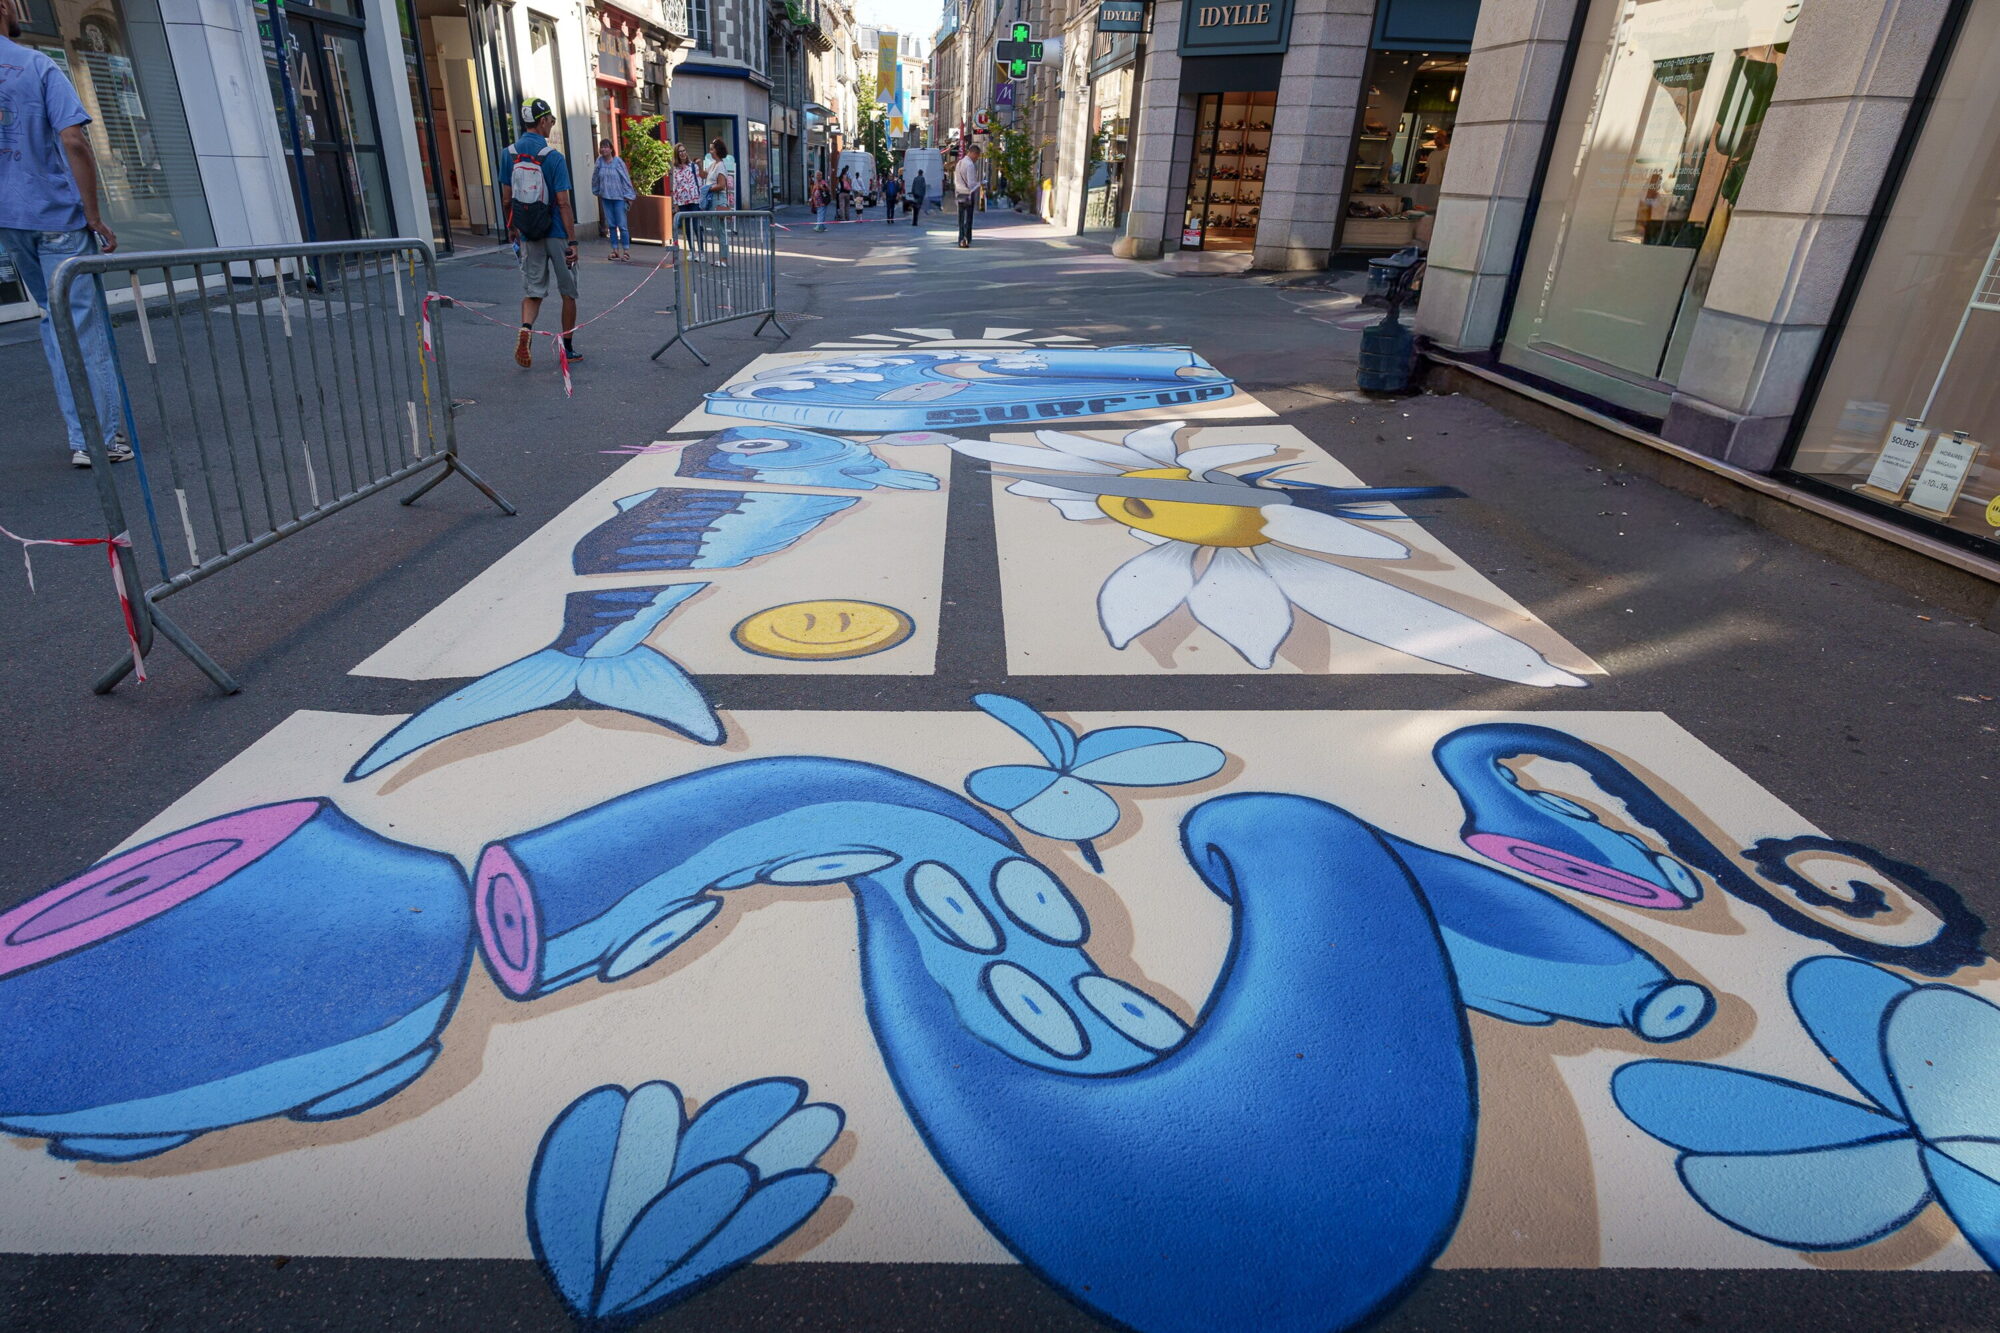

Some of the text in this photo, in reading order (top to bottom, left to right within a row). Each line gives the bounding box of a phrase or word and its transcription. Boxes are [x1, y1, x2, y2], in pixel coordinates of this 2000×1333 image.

[1103, 10, 1141, 22] IDYLLE
[1197, 3, 1271, 28] IDYLLE
[300, 52, 318, 111] 4
